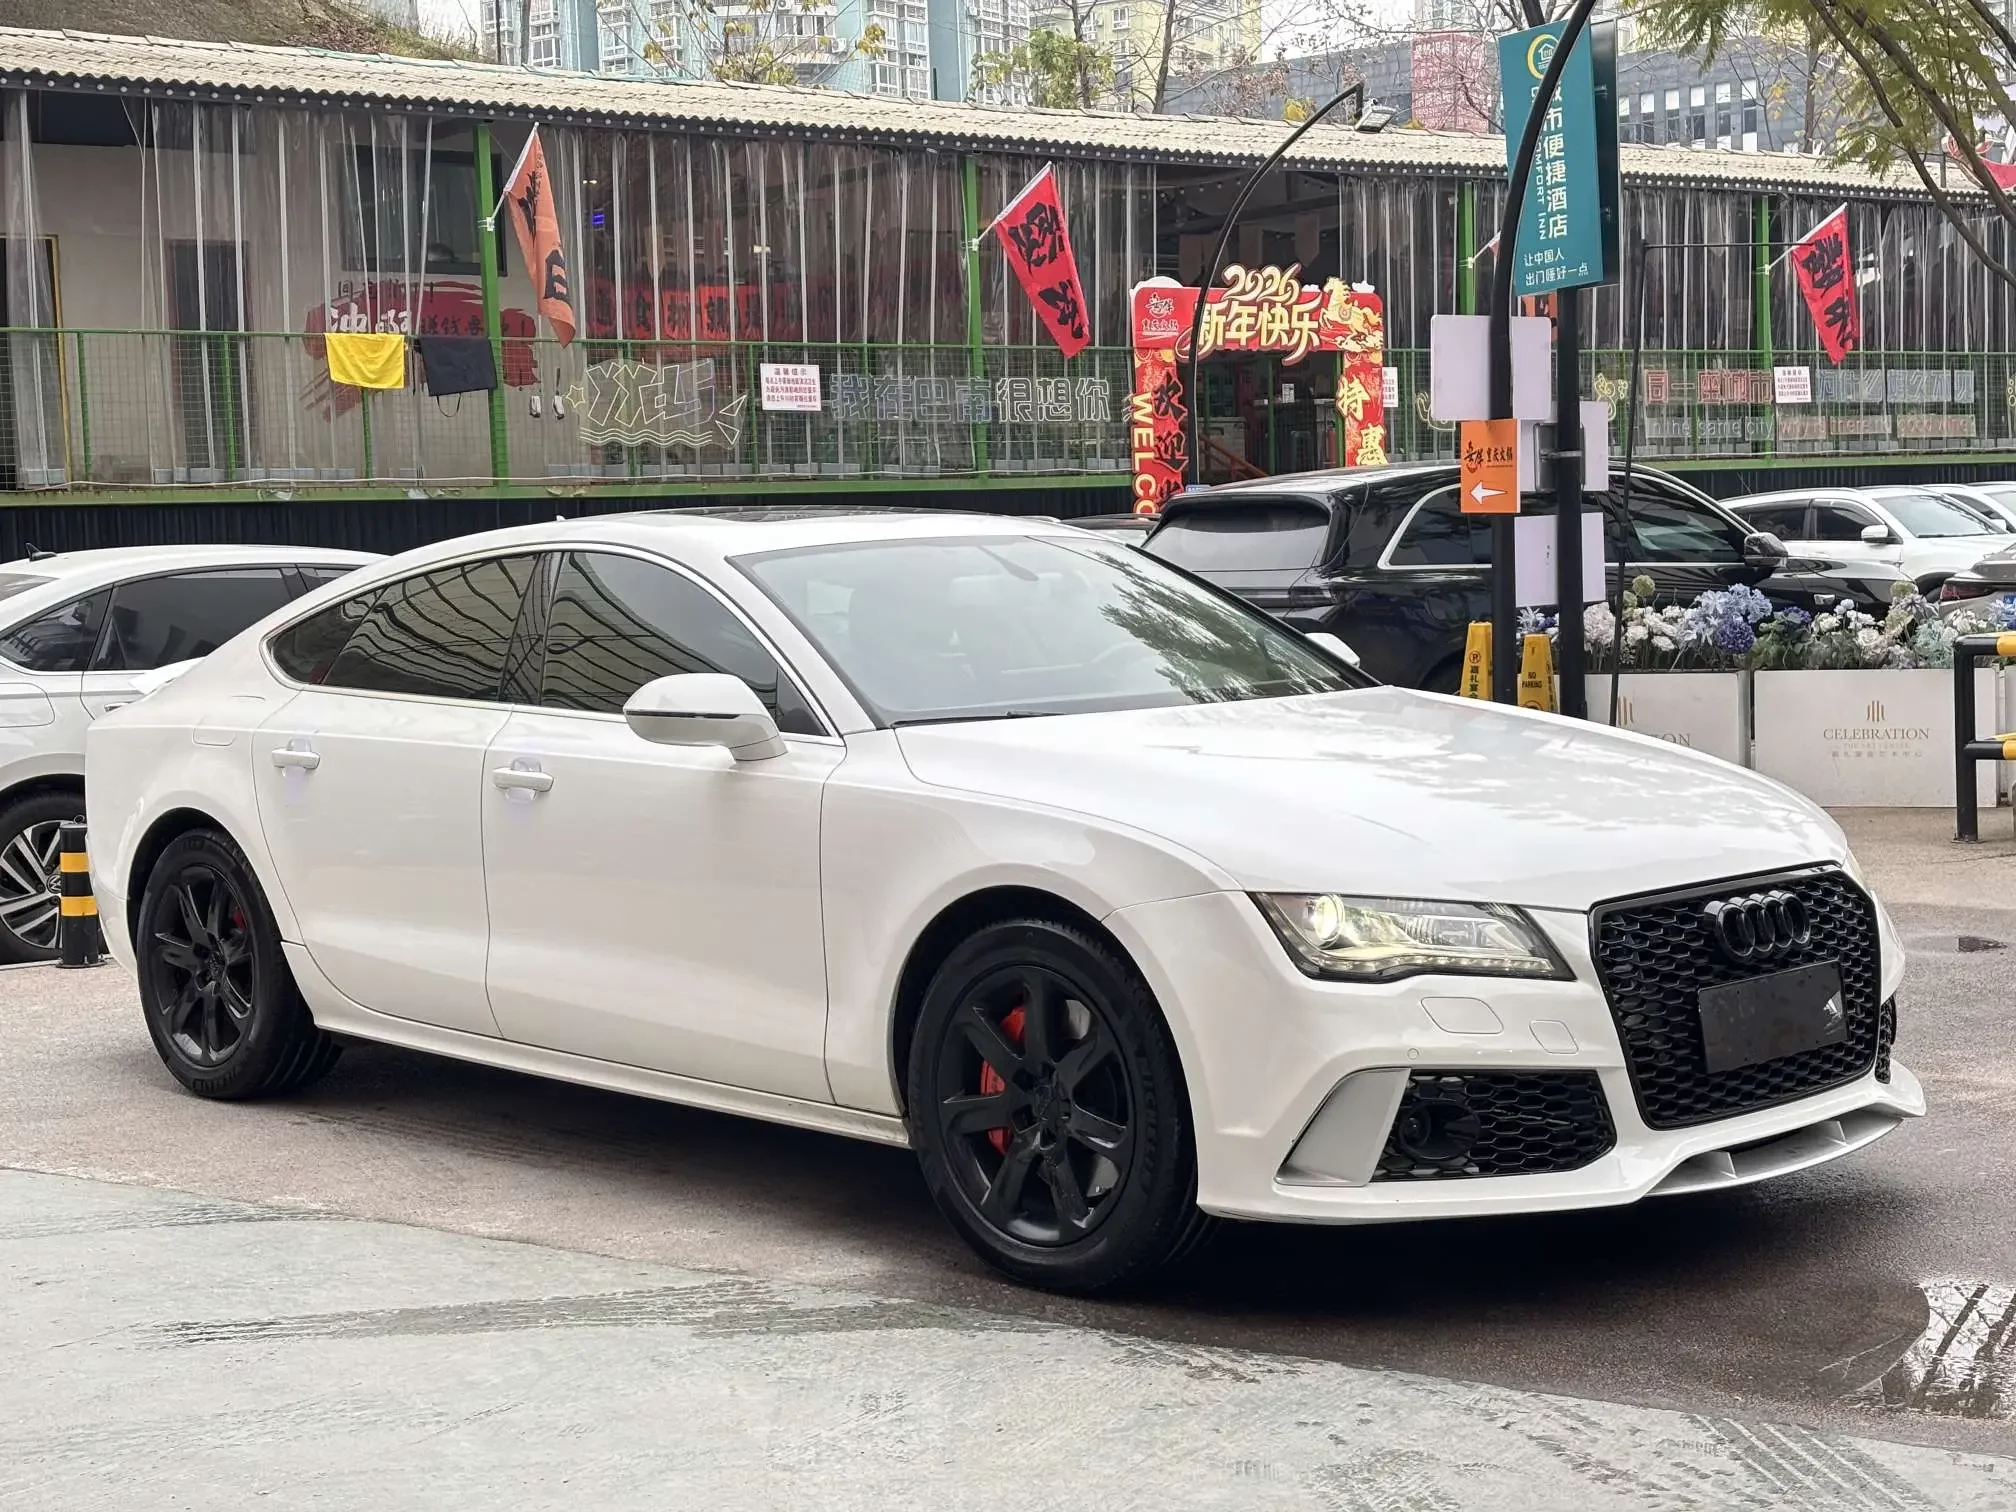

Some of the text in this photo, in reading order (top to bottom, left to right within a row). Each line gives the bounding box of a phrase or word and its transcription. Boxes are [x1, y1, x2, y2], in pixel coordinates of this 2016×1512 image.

[1537, 212, 1547, 240] INN
[1523, 247, 1565, 267] 让中国人
[1221, 263, 1300, 306] 2026
[1525, 262, 1589, 287] 出门睡好一点
[1190, 290, 1322, 362] 新年快乐
[830, 373, 1111, 423] 我在巴南很想你
[1645, 369, 1773, 405] 同一座城市
[1337, 374, 1388, 466] 特惠
[1521, 681, 1543, 689] PARKING
[1527, 671, 1537, 680] NO
[1823, 728, 1930, 741] CELEBRATION
